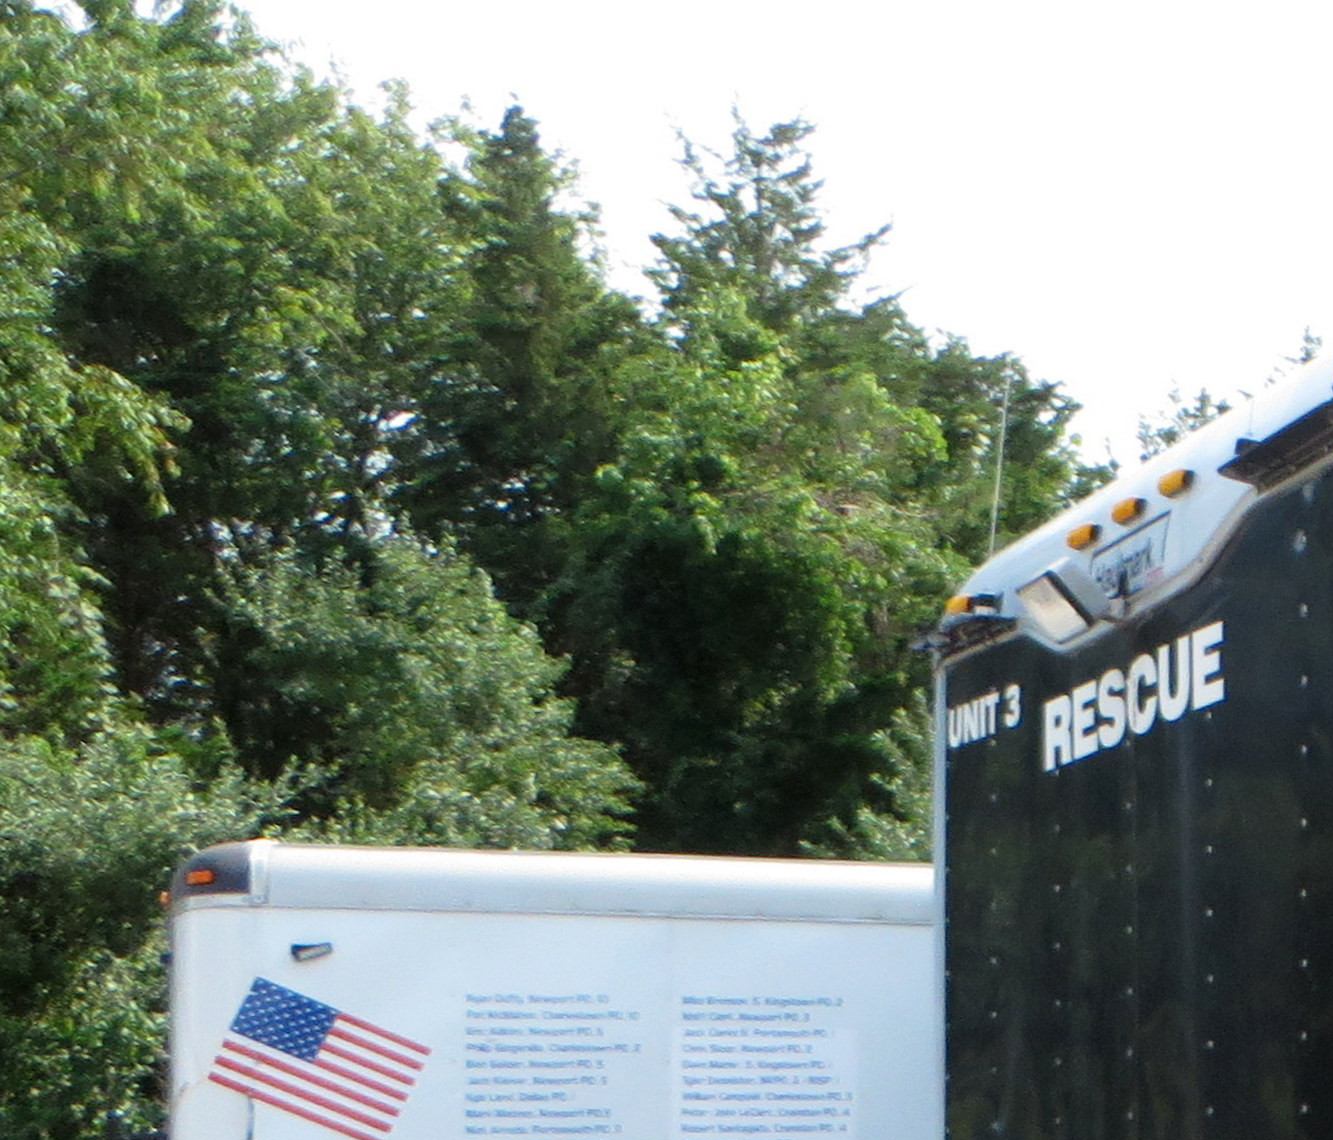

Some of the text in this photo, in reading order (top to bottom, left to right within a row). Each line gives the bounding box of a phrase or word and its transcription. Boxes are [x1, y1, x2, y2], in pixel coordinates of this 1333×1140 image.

[947, 682, 1022, 749] UNIT 3
[1042, 620, 1226, 774] RESCUE
